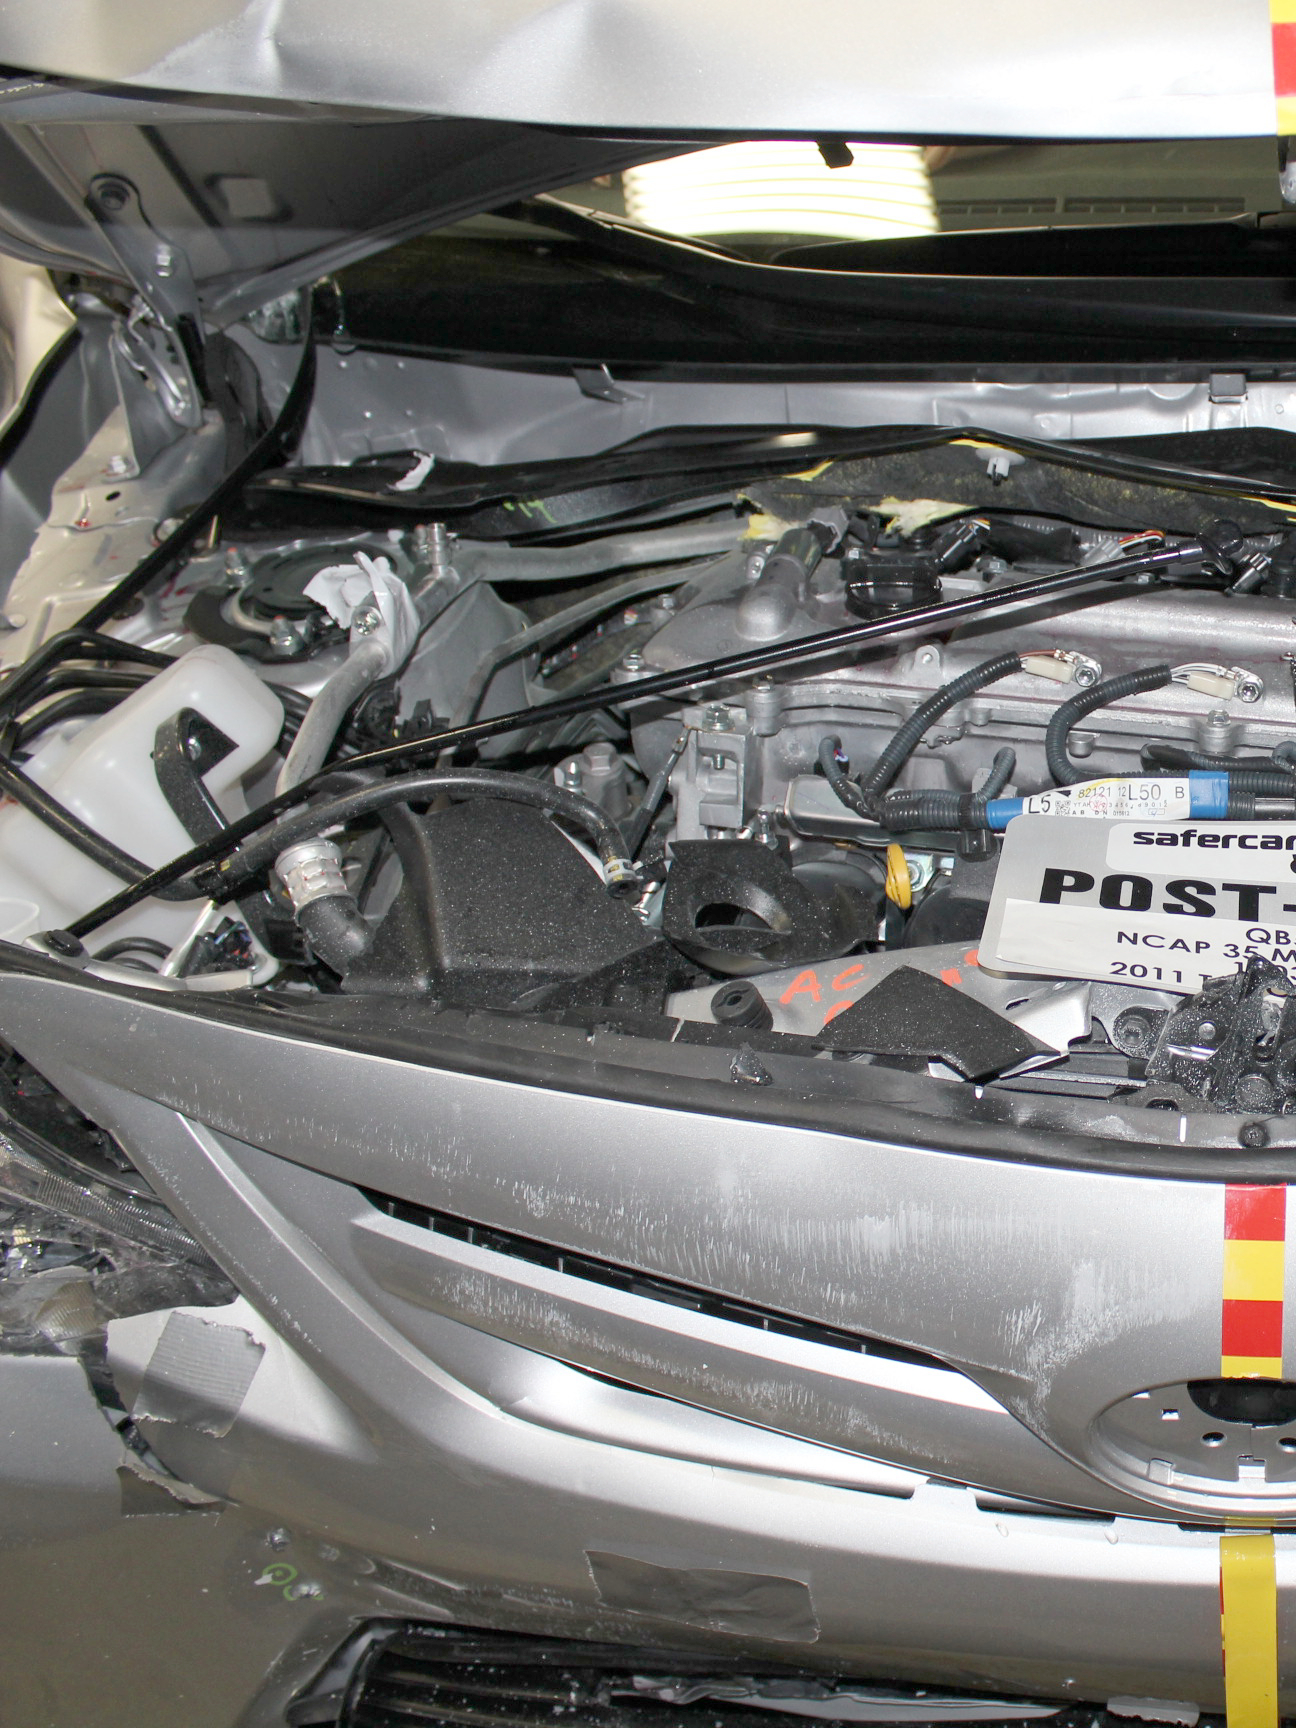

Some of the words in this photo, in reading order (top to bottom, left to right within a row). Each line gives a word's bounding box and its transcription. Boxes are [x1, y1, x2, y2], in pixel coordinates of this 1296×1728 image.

[1078, 787, 1111, 799] 82121
[1175, 787, 1185, 799] B
[1117, 931, 1211, 954] NCAP
[1110, 961, 1183, 983] 2011
